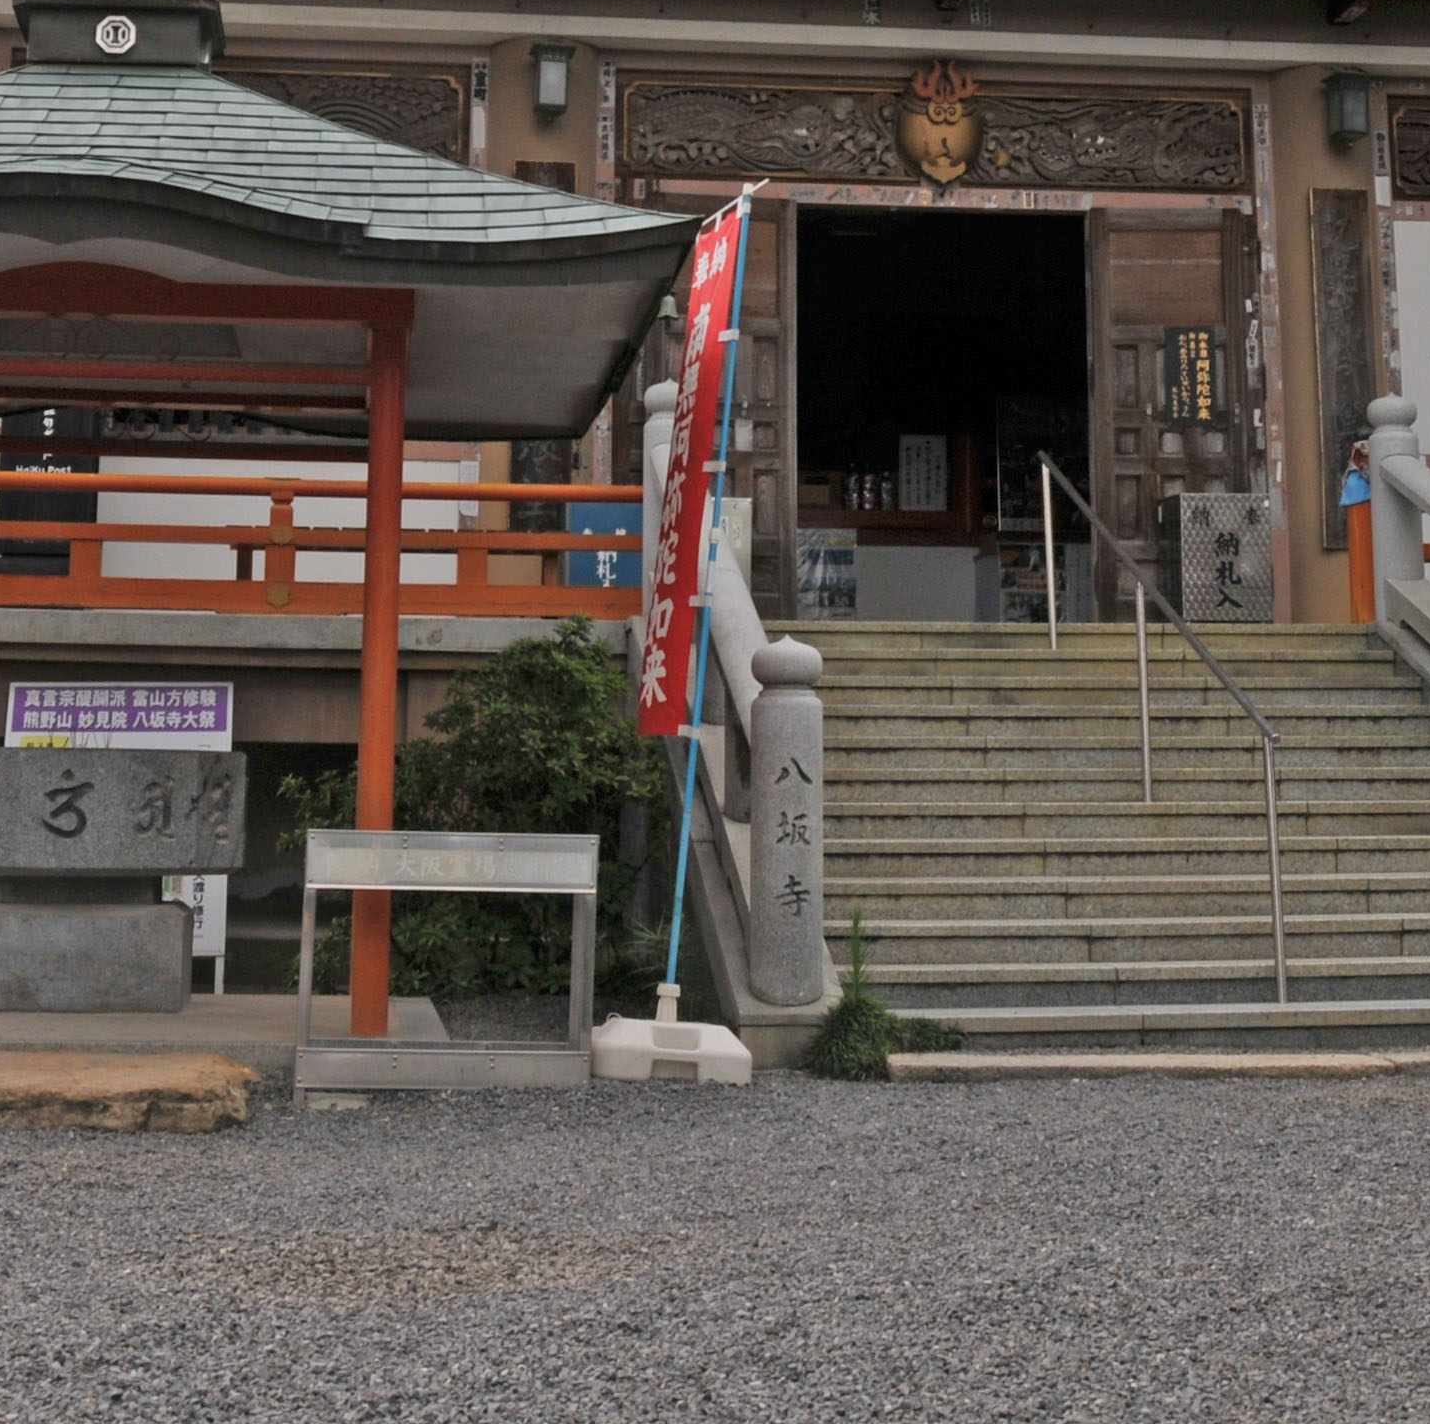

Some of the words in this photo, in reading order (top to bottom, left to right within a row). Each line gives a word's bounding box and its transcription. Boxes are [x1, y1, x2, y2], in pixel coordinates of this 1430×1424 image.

[1214, 532, 1243, 609] 納札入
[23, 711, 73, 729] 熊野山
[77, 711, 128, 729] 妙見院
[132, 711, 216, 730] 八坂寺大祭
[775, 757, 813, 916] 八坂寺
